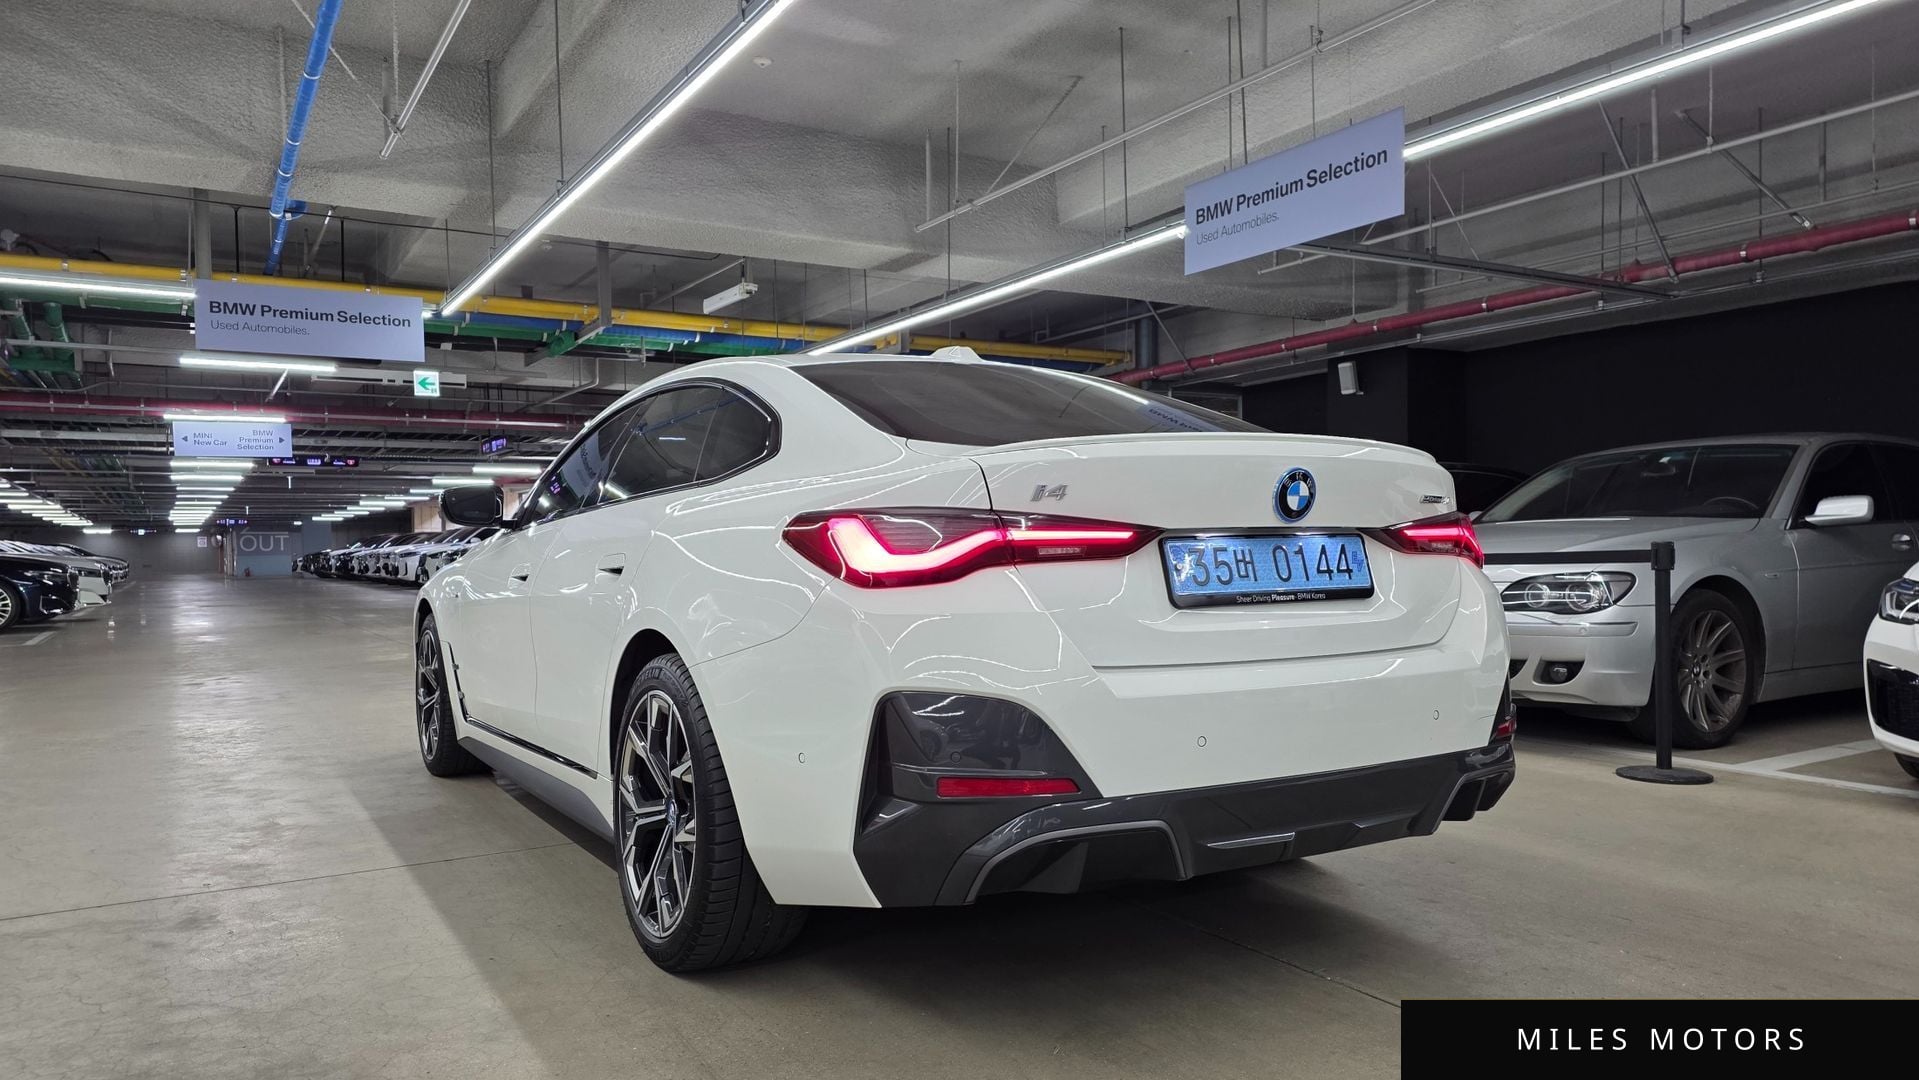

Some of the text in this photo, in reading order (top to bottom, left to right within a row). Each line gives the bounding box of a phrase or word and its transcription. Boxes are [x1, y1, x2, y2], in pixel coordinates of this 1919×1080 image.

[1196, 149, 1388, 225] BMW Premium Selection
[1196, 228, 1218, 245] Used
[208, 300, 412, 328] BMW Premium Selection
[210, 320, 310, 336] Used Automobiles.
[237, 443, 274, 451] Selection
[1030, 484, 1068, 501] i4
[240, 535, 289, 551] OUT
[1272, 542, 1354, 583] 0144
[1236, 595, 1252, 603] Sheer
[1253, 594, 1271, 603] Driving
[1297, 592, 1311, 600] BMW
[1312, 592, 1326, 600] Korea
